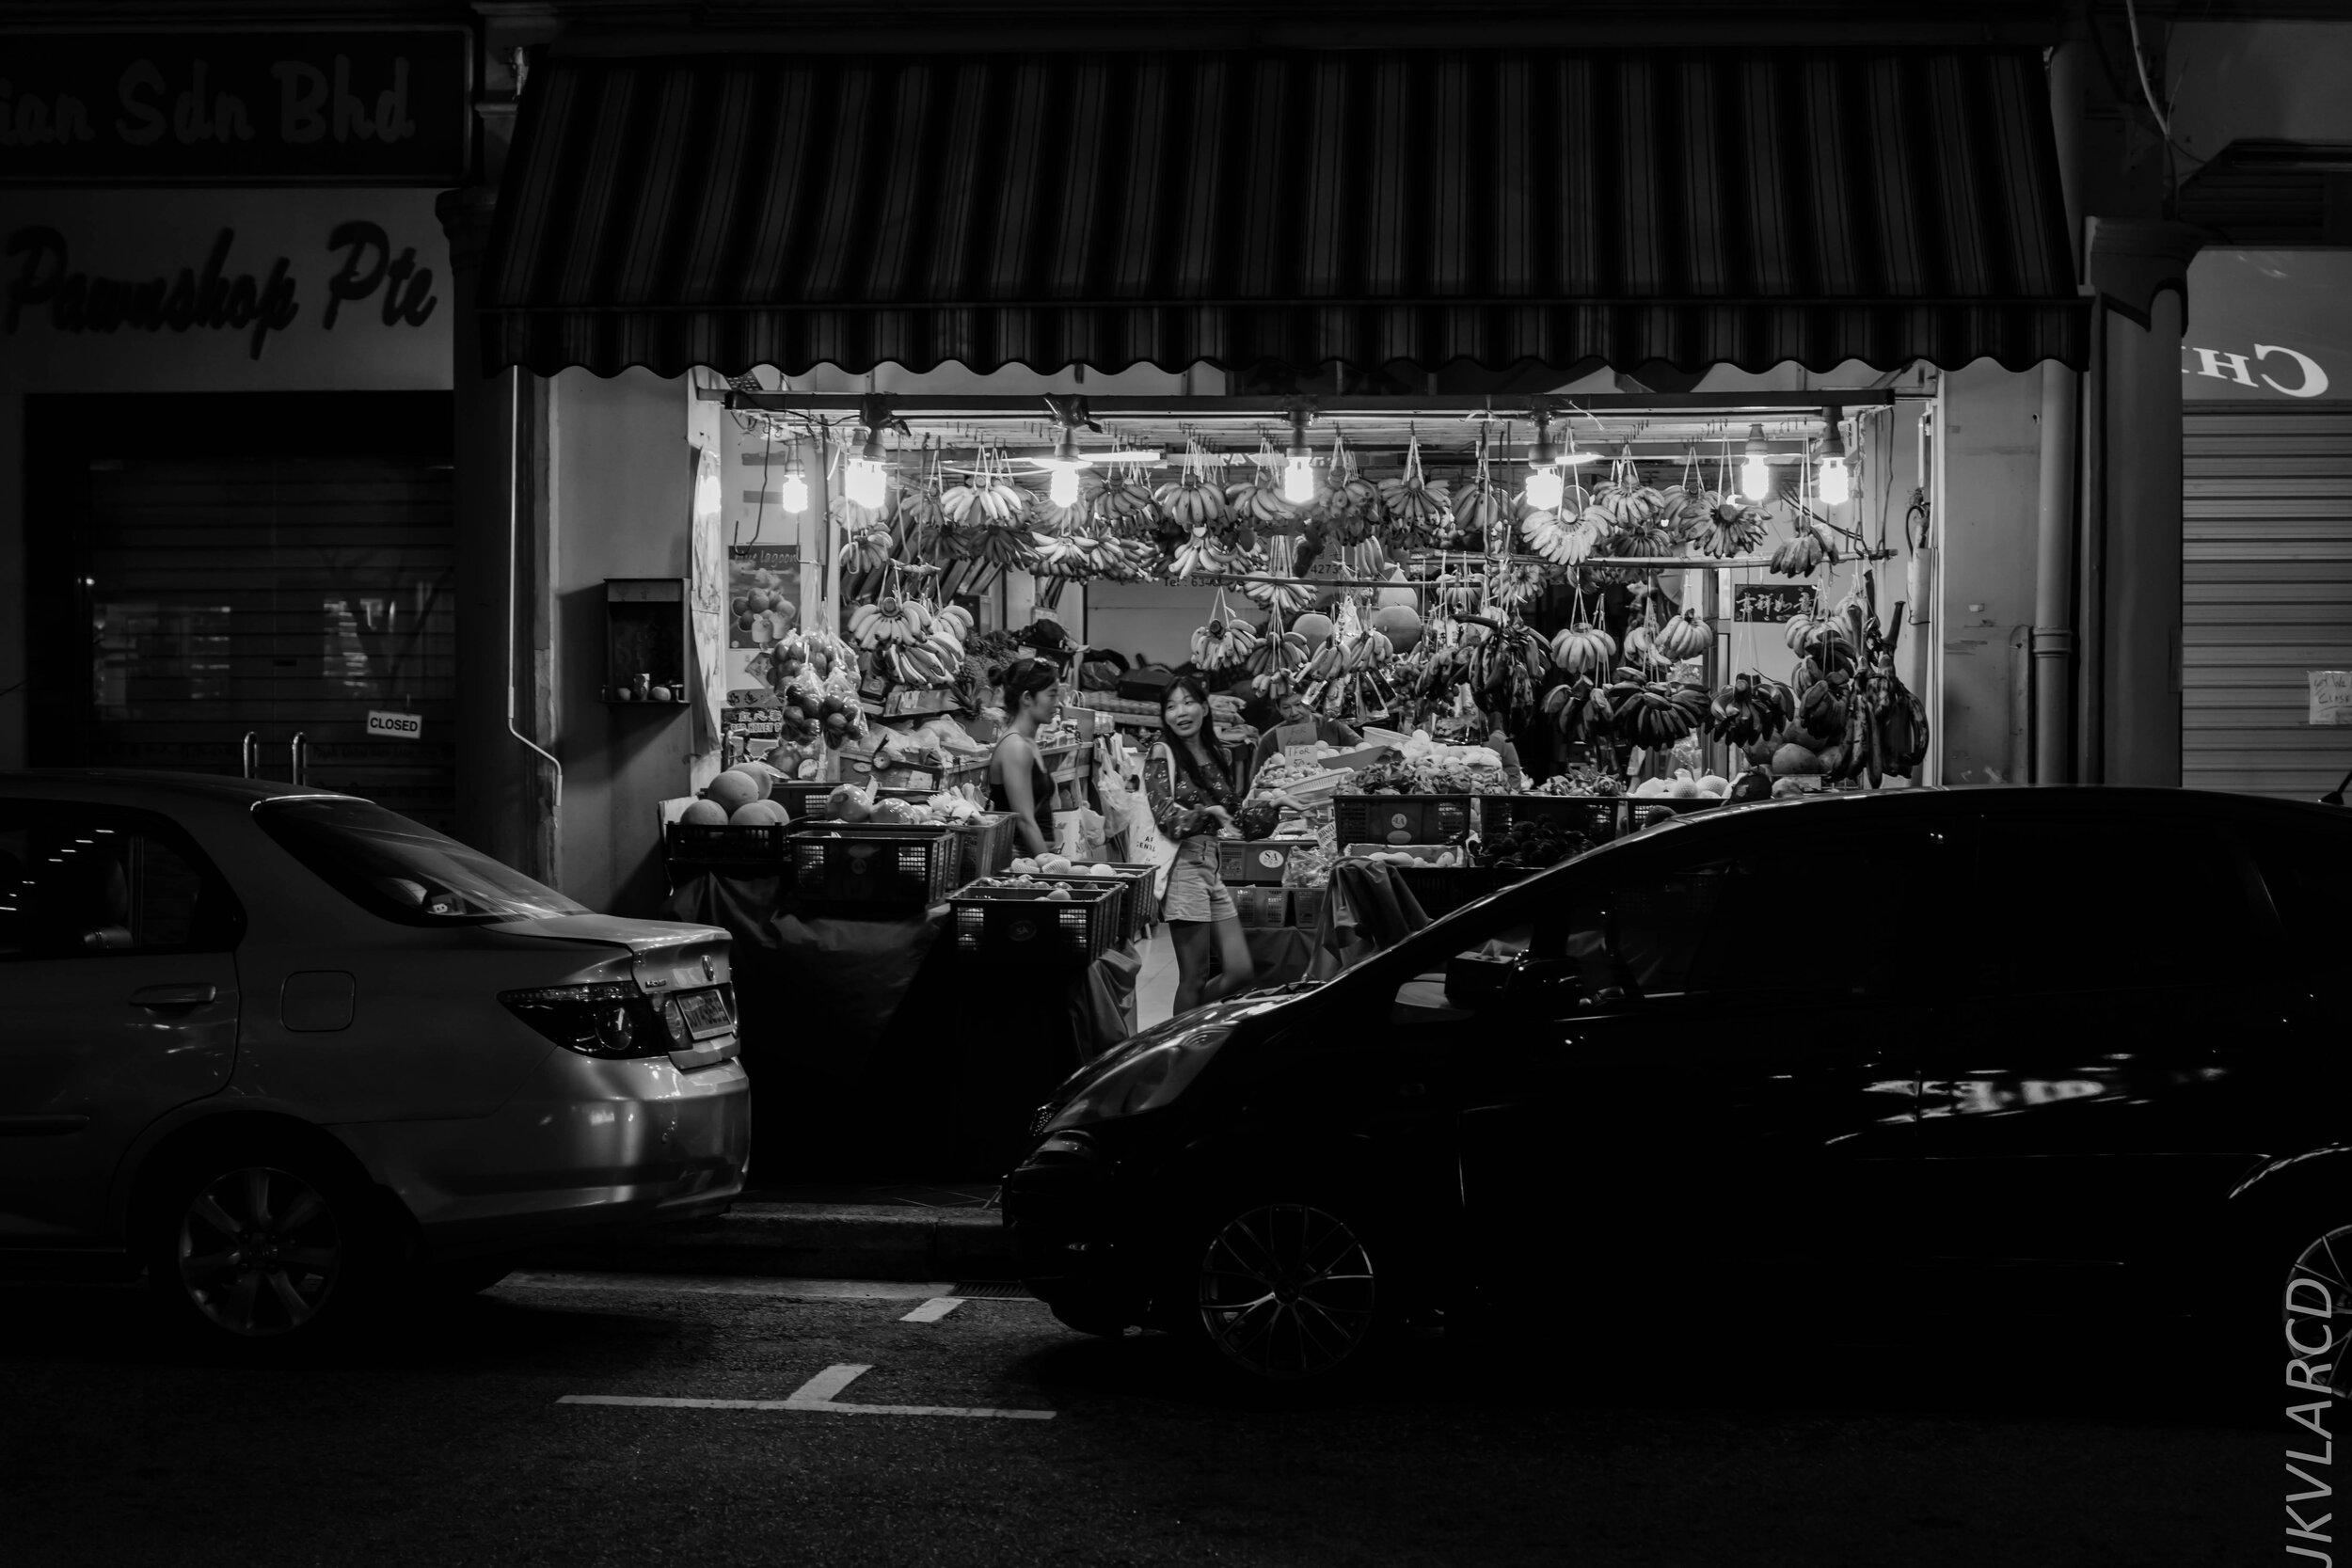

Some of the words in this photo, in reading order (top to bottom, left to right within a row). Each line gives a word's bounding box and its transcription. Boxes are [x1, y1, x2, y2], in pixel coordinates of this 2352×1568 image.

[114, 57, 256, 147] Sdn
[270, 53, 416, 145] Bhd
[5, 225, 299, 361] Pawnshop
[324, 219, 437, 331] Pte
[1736, 592, 1817, 617] 吉祥如意
[370, 717, 418, 732] CLOSED
[748, 722, 774, 733] HONEY
[1294, 746, 1311, 757] FOR
[1263, 851, 1278, 861] SA
